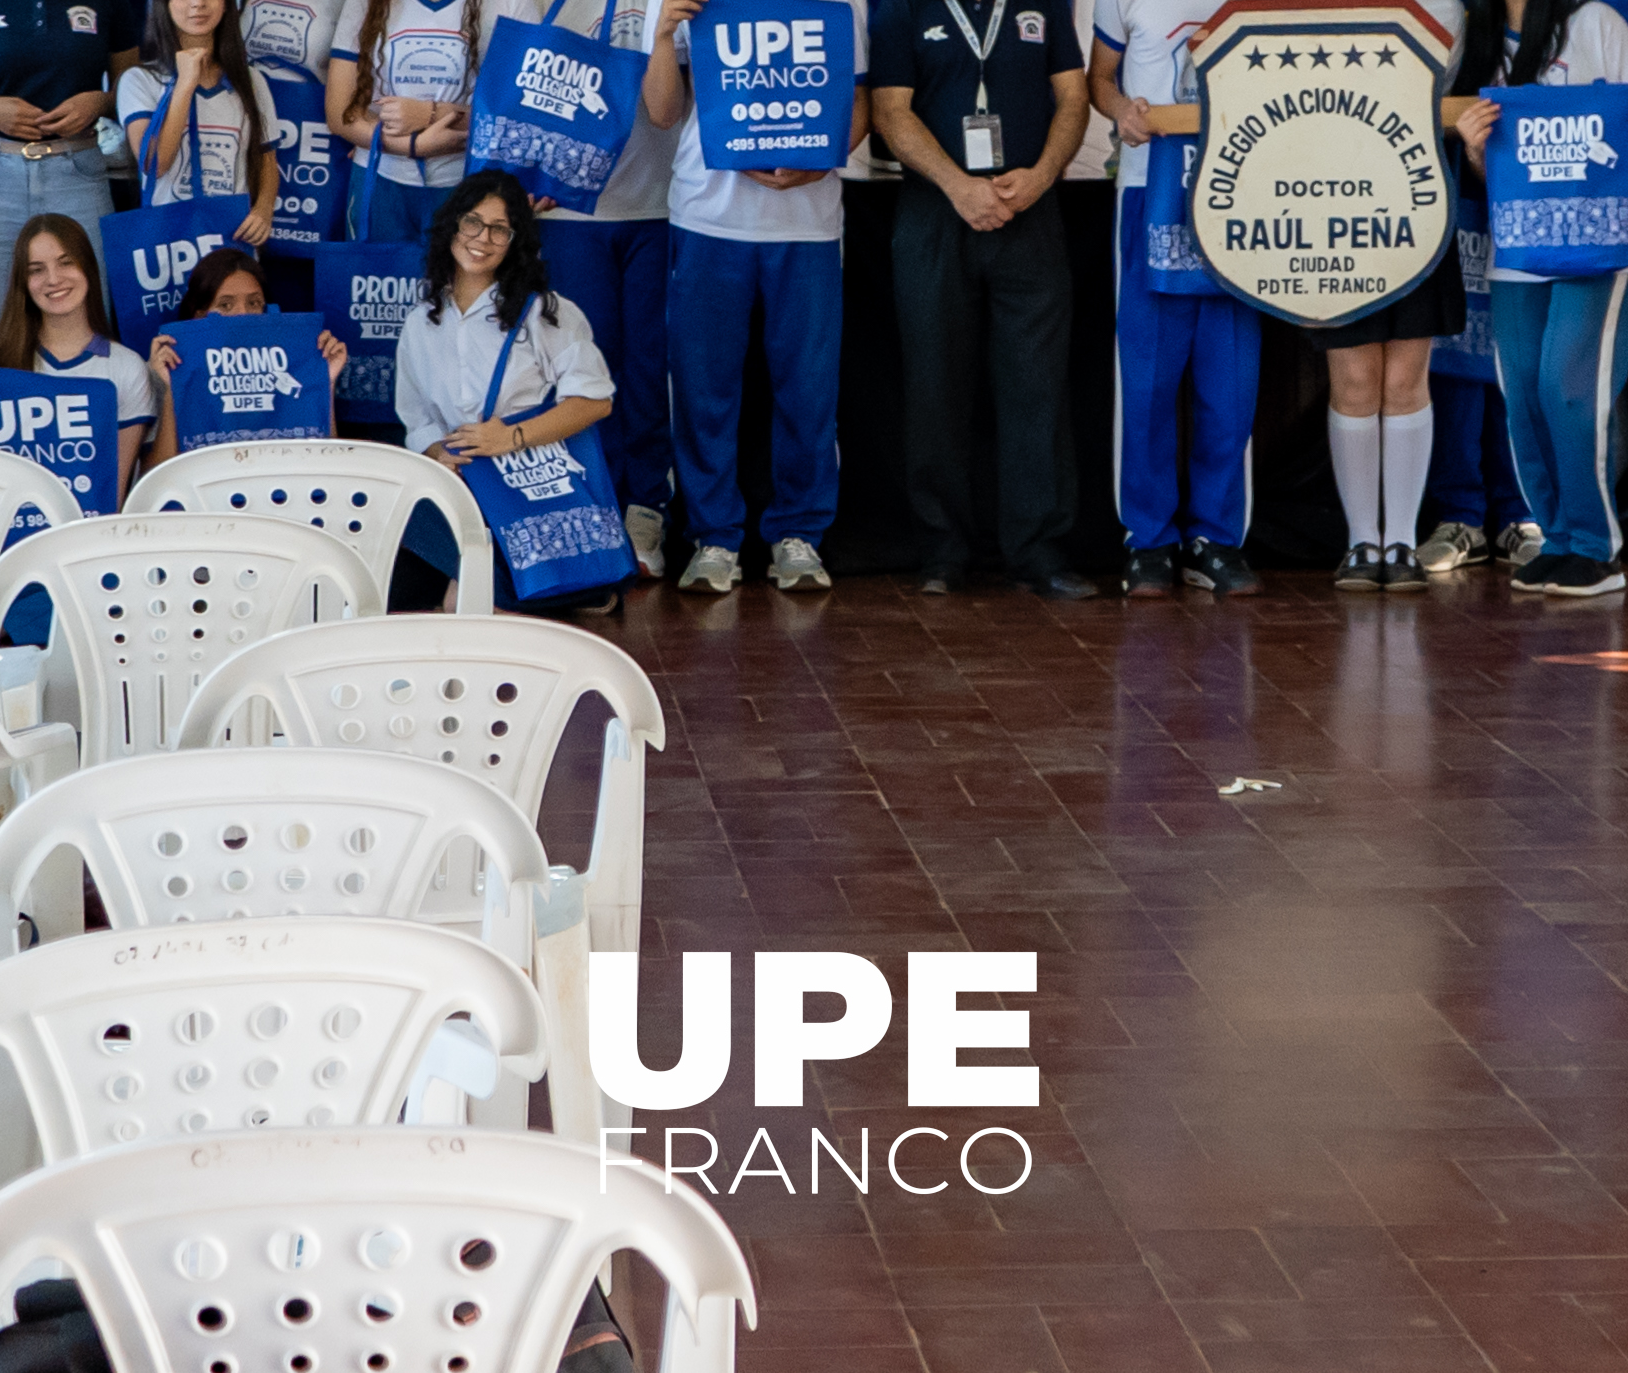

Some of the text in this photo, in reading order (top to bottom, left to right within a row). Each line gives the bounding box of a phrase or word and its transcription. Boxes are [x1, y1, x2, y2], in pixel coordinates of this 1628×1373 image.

[715, 20, 826, 68] UPE
[522, 47, 603, 93] PROMO
[721, 65, 829, 91] FRANCO
[533, 94, 565, 115] UPE
[1518, 114, 1604, 145] PROMO
[725, 134, 829, 151] +595 984364238
[1208, 114, 1267, 211] COLEGIO
[1266, 87, 1377, 128] NACIONAL
[1377, 111, 1412, 150] DE
[1399, 142, 1438, 212] E.M.D.
[1541, 166, 1574, 179] UPE
[1274, 179, 1373, 198] DOCTOR
[1226, 208, 1416, 252] RAÚL PEÑA
[1289, 256, 1356, 275] CIUDAD
[1257, 276, 1387, 296] PDTE. FRANCO
[141, 288, 183, 316] FRA
[206, 346, 288, 376] PROMO
[233, 397, 264, 409] UPE
[531, 483, 562, 497] UPE
